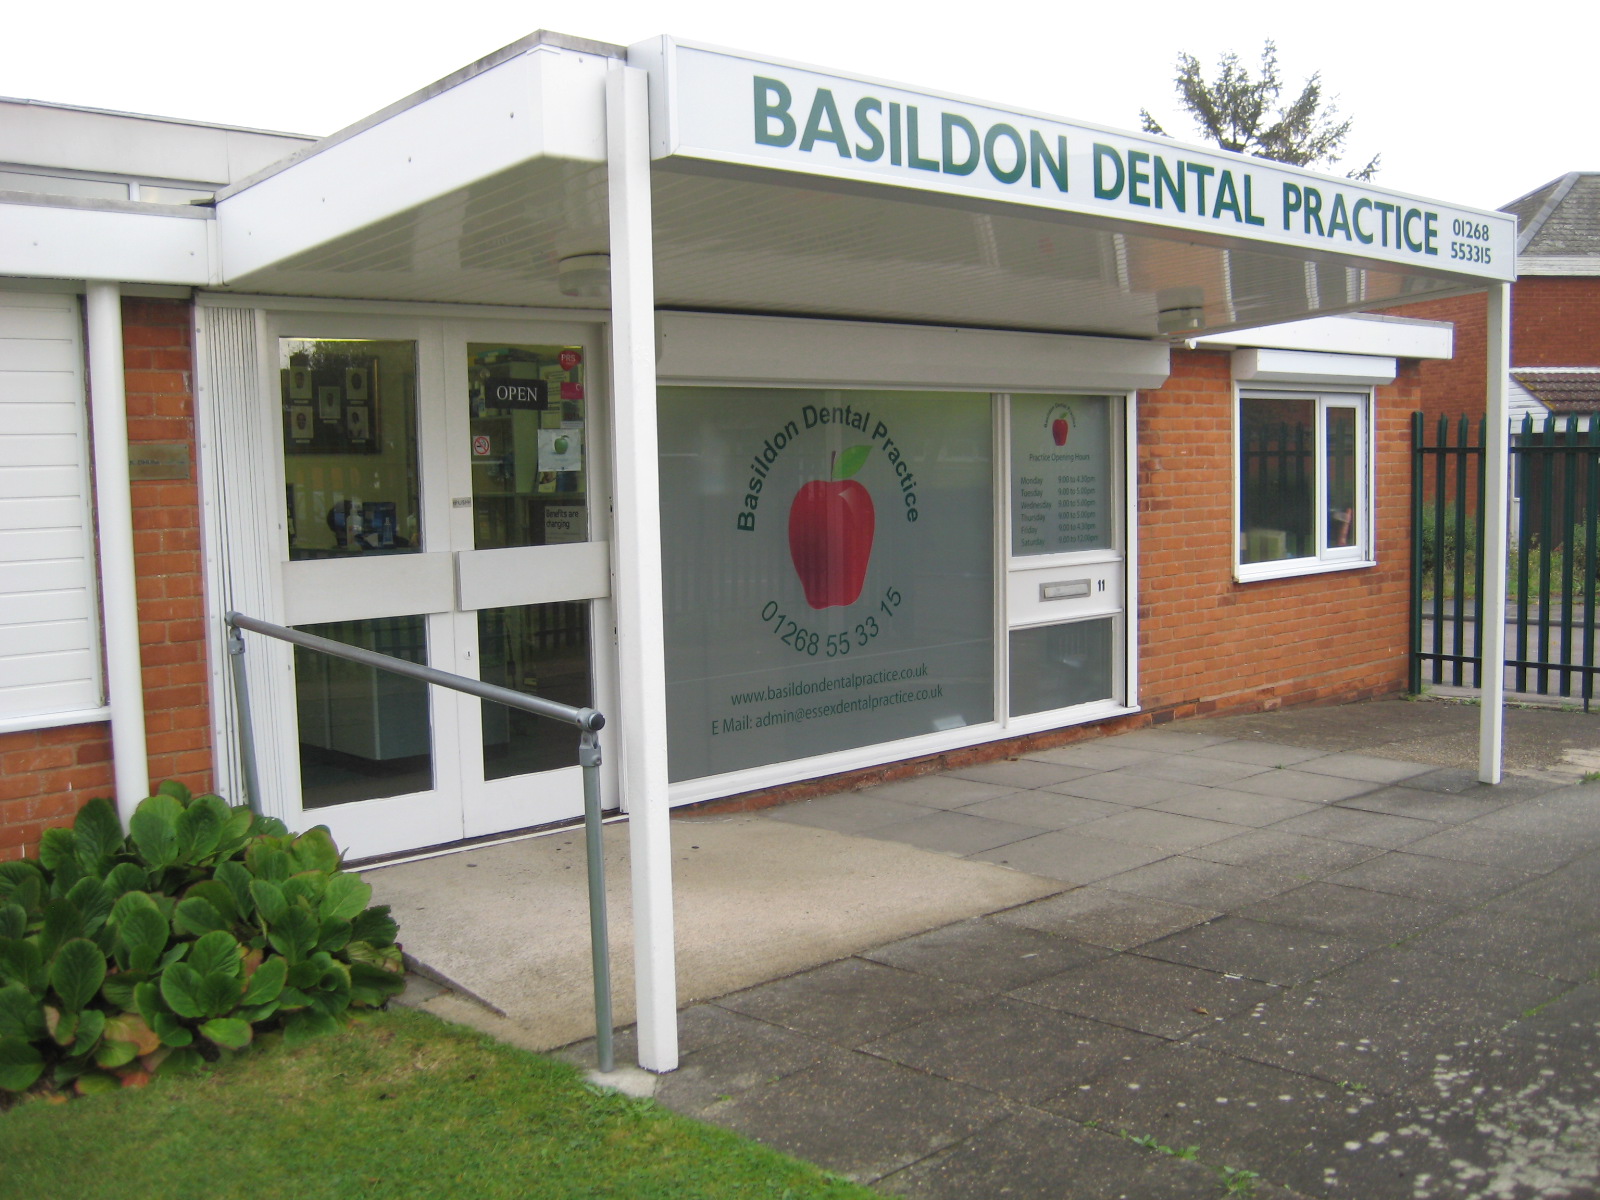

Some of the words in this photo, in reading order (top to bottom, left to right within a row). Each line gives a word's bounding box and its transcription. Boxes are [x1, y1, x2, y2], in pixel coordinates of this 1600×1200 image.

[753, 75, 1069, 193] BASILDON
[1093, 143, 1265, 226] DENTAL
[1283, 182, 1438, 255] PRACTICE
[1453, 218, 1489, 242] 01268
[1450, 241, 1492, 265] 553315
[496, 385, 538, 402] OPEN
[737, 419, 799, 532] Basildon
[802, 404, 870, 433] Dental
[872, 421, 918, 523] Practice
[1029, 453, 1051, 462] Practice
[1051, 453, 1075, 463] Opening
[1075, 453, 1090, 462] Hours
[1020, 476, 1043, 485] Monday
[1021, 488, 1043, 497] Tuesday
[1097, 579, 1105, 592] 11
[761, 601, 820, 656] 01268
[826, 632, 850, 657] 55
[855, 616, 879, 646] 33
[880, 586, 901, 617] 15
[731, 662, 928, 706] www.basildondentalpractice.co.uk
[711, 719, 719, 736] E
[723, 715, 752, 734] Mail:
[755, 684, 943, 729] admin@essexdentalpractice.co.uk
